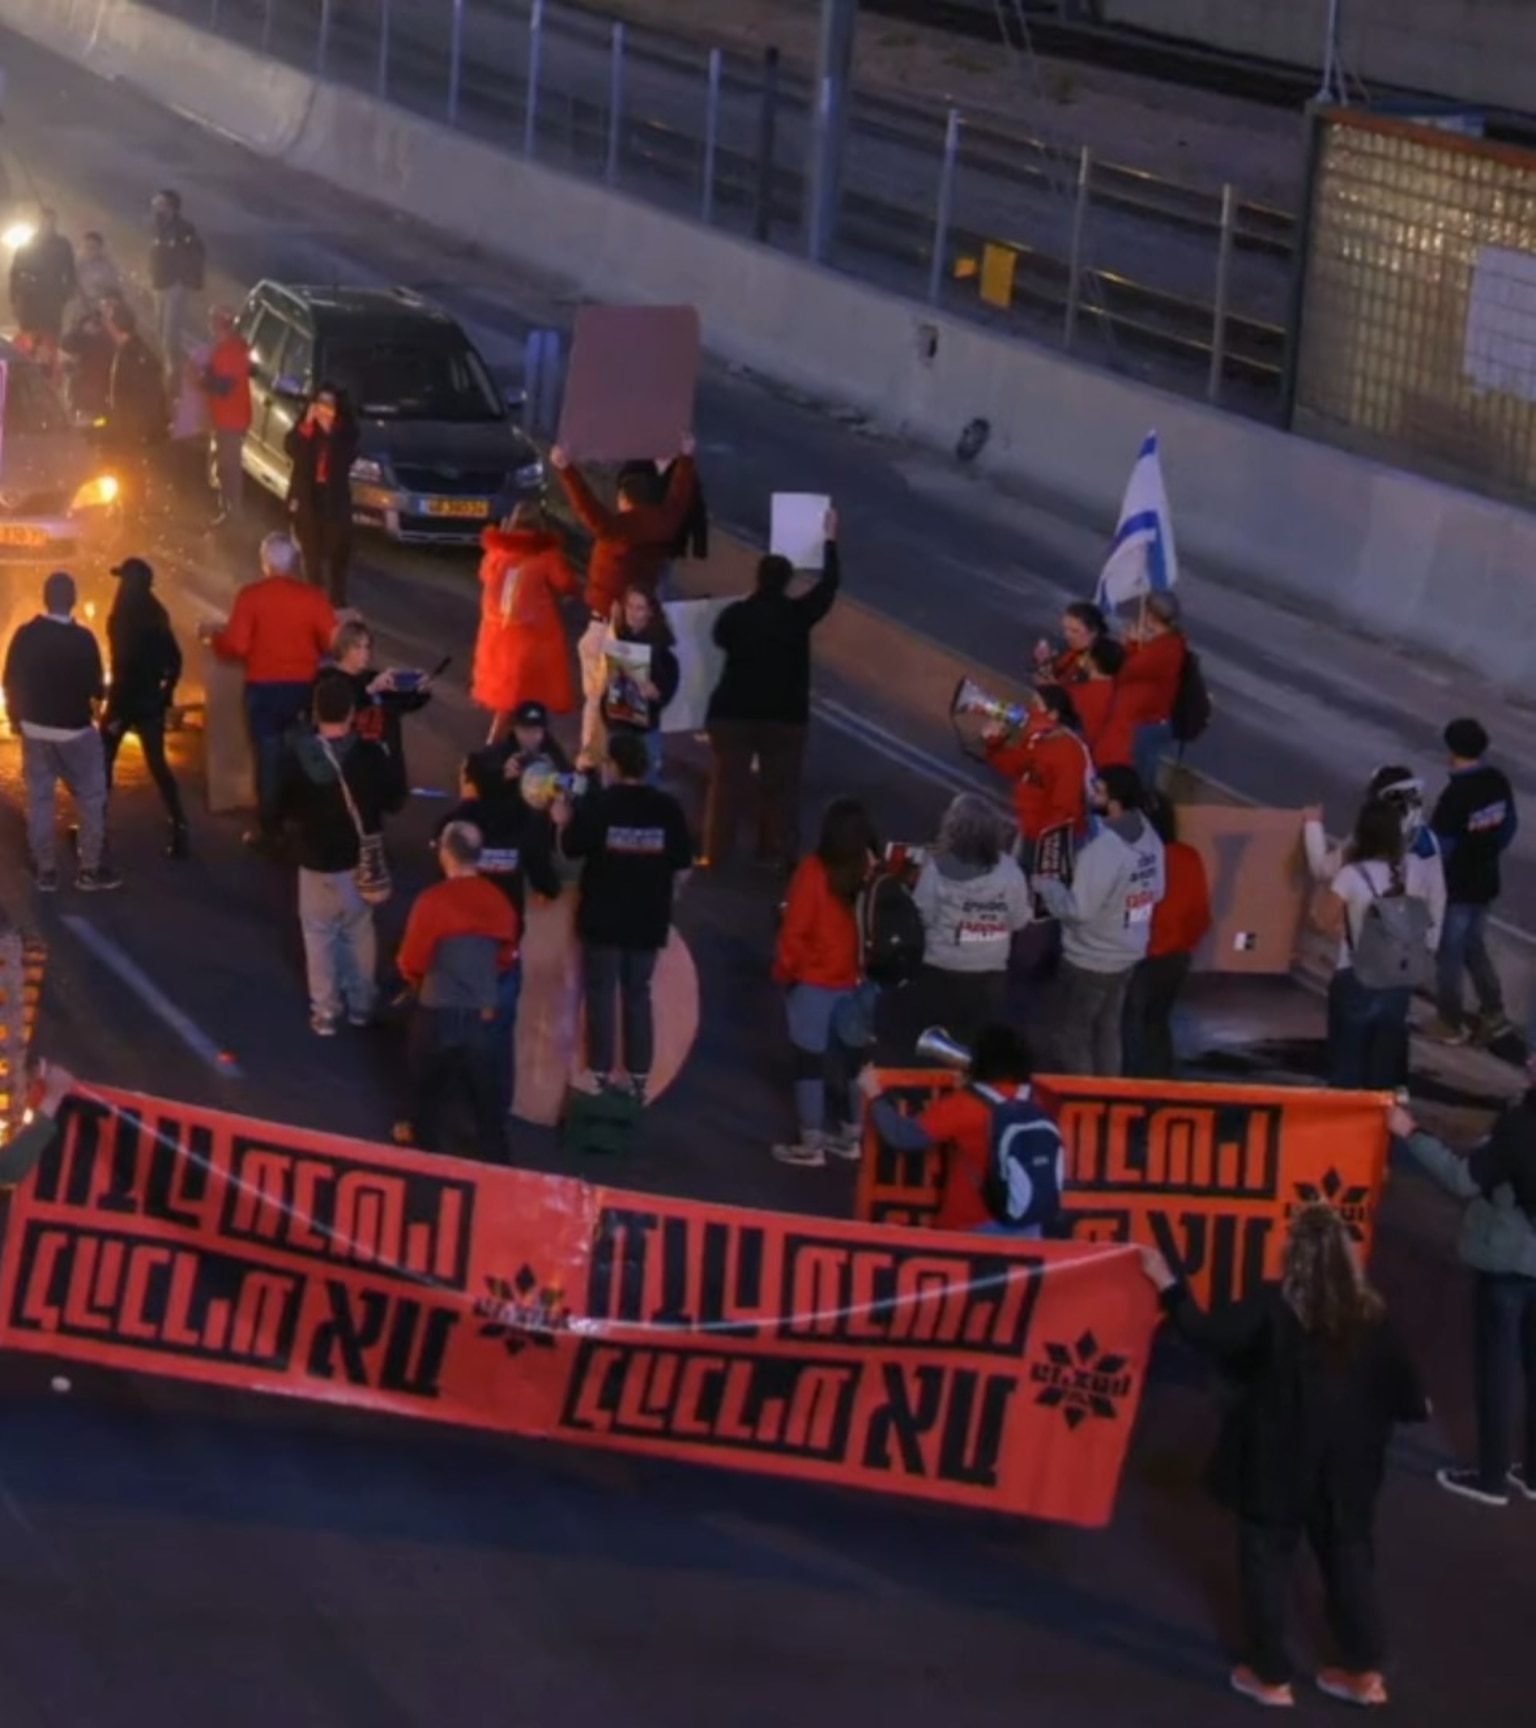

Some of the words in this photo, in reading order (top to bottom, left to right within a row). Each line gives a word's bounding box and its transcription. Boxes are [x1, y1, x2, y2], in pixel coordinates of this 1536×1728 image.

[35, 1094, 213, 1225] עזה
[236, 1149, 463, 1279] עכשיו
[20, 1229, 296, 1361] להכריע
[310, 1281, 459, 1396] את
[589, 1209, 766, 1336] עזה
[788, 1247, 1032, 1347] עכשיו
[572, 1347, 851, 1453] להכריע
[862, 1361, 1017, 1487] את
